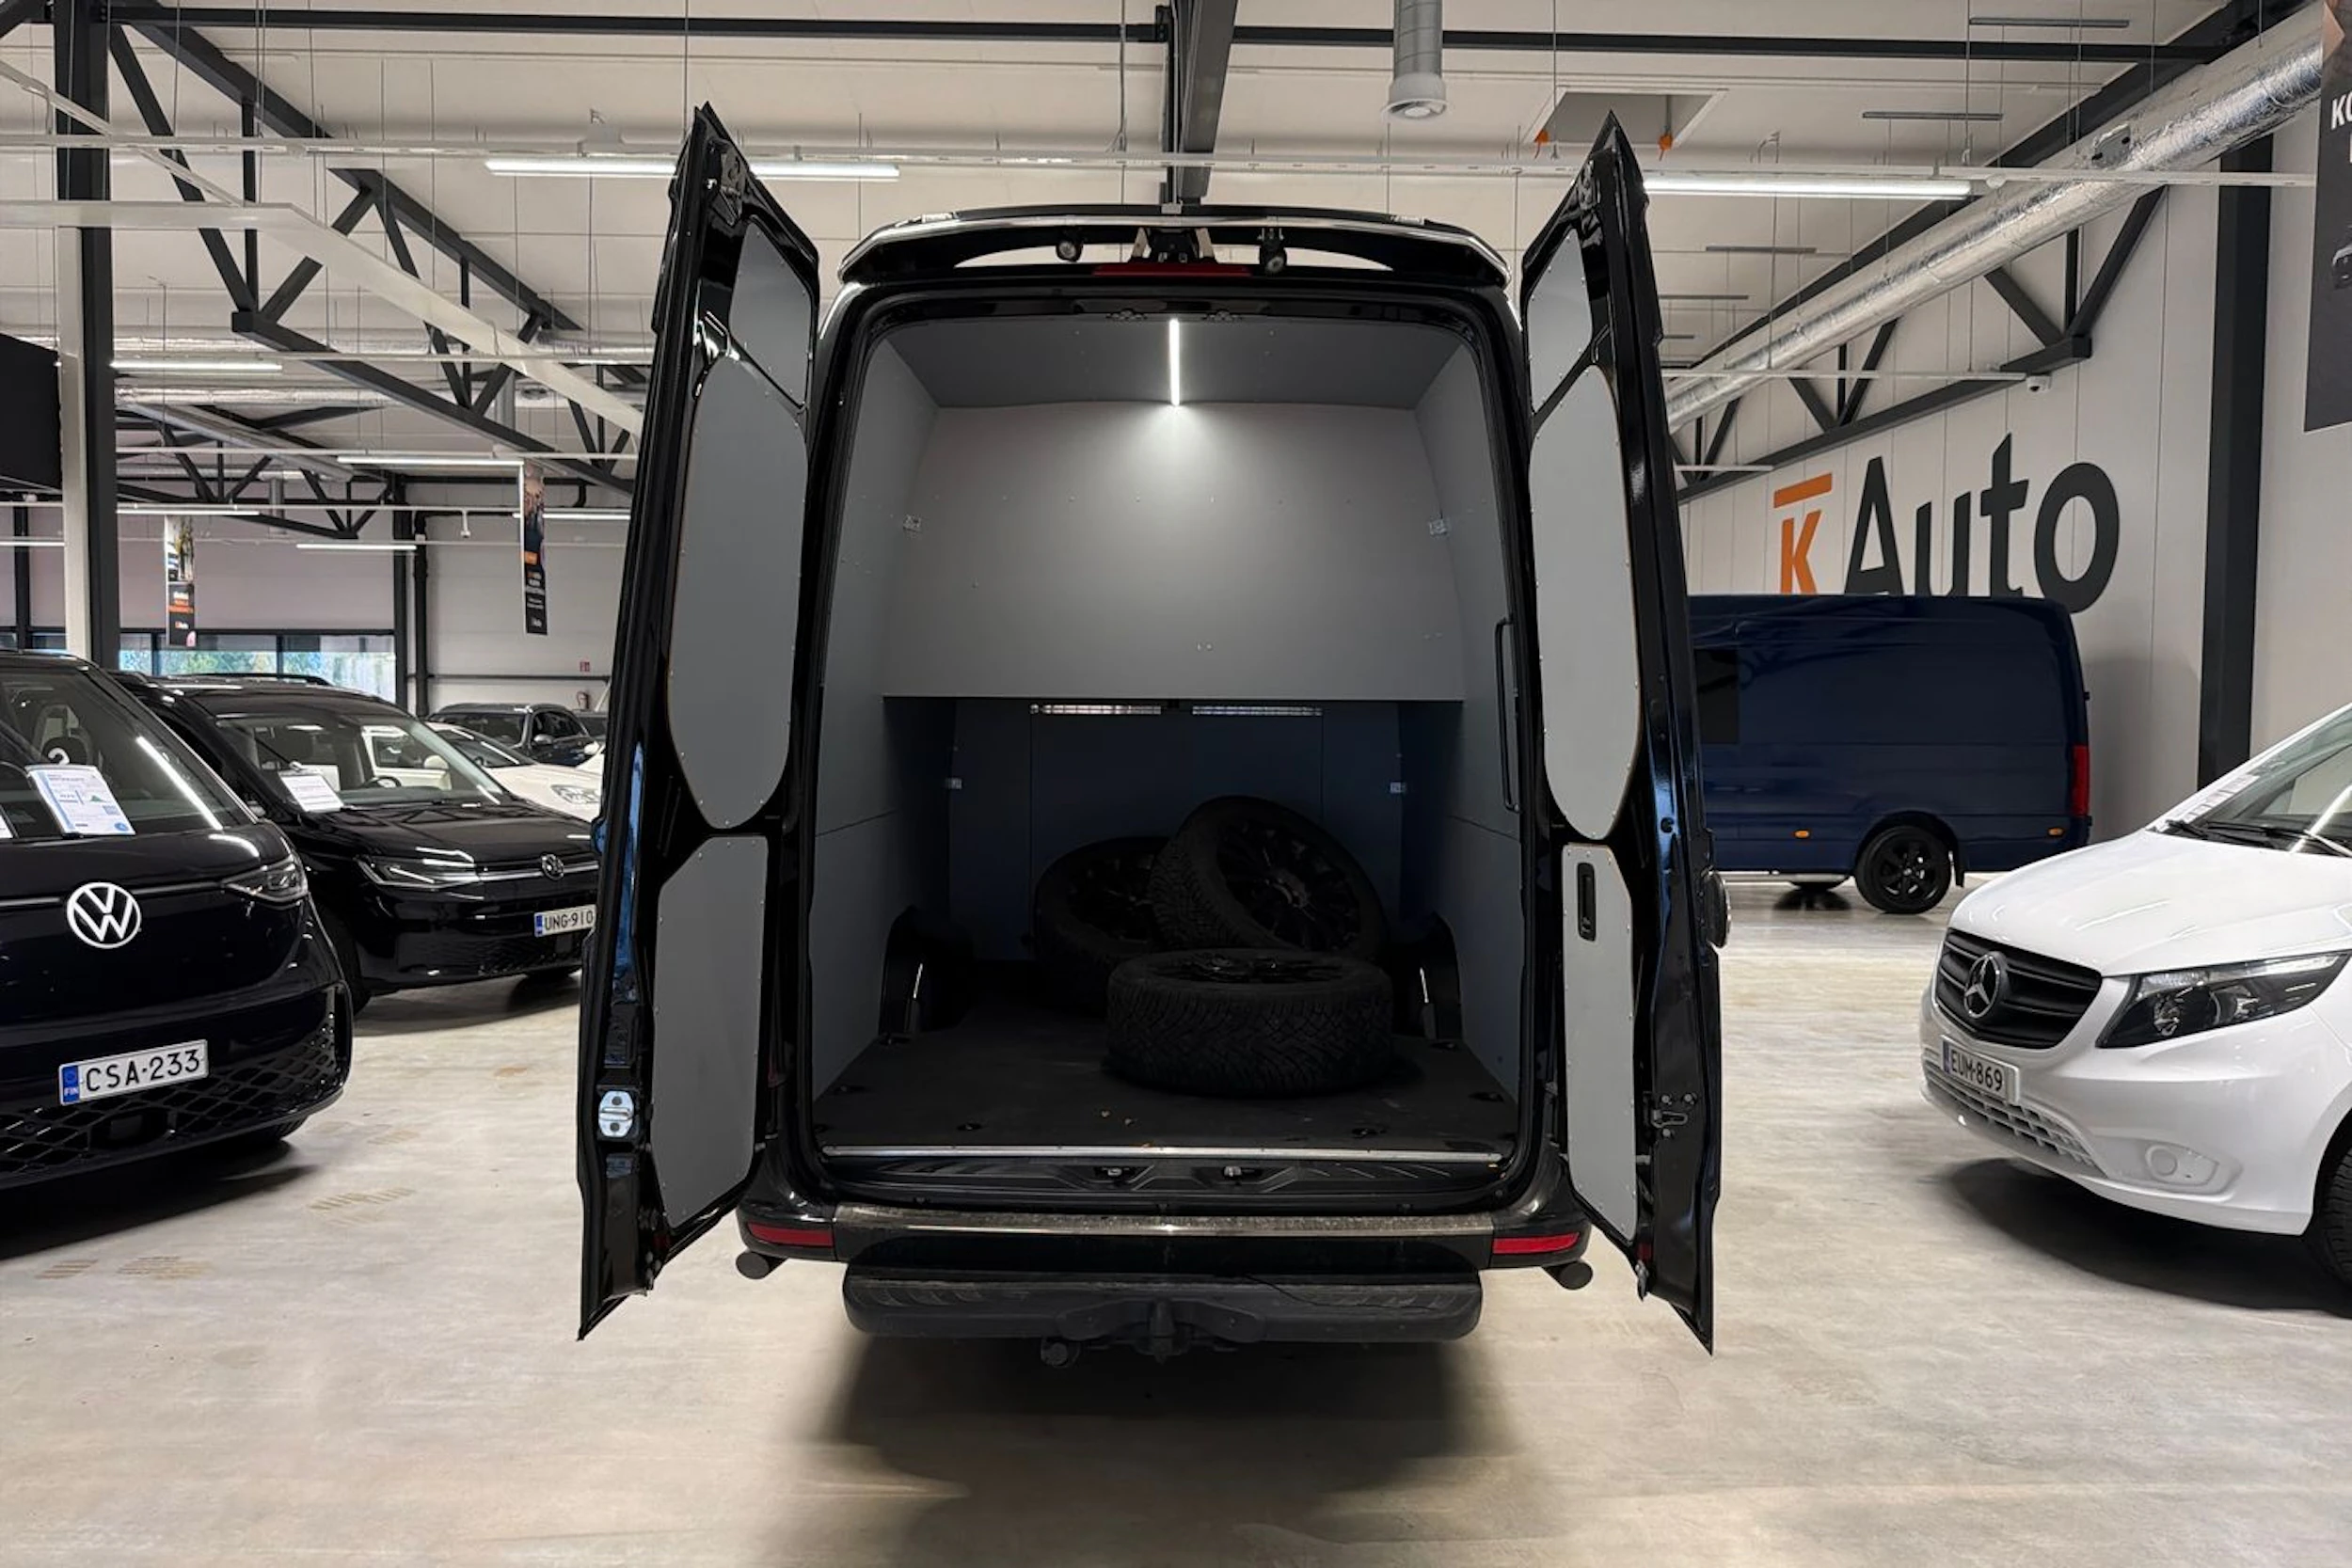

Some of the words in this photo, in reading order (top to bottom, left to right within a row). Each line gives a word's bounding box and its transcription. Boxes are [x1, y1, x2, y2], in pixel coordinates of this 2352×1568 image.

[1844, 433, 2120, 615] Auto
[545, 910, 594, 930] UNG-910
[86, 1049, 199, 1092] CSA-233
[1950, 1049, 2003, 1092] EUM-869
